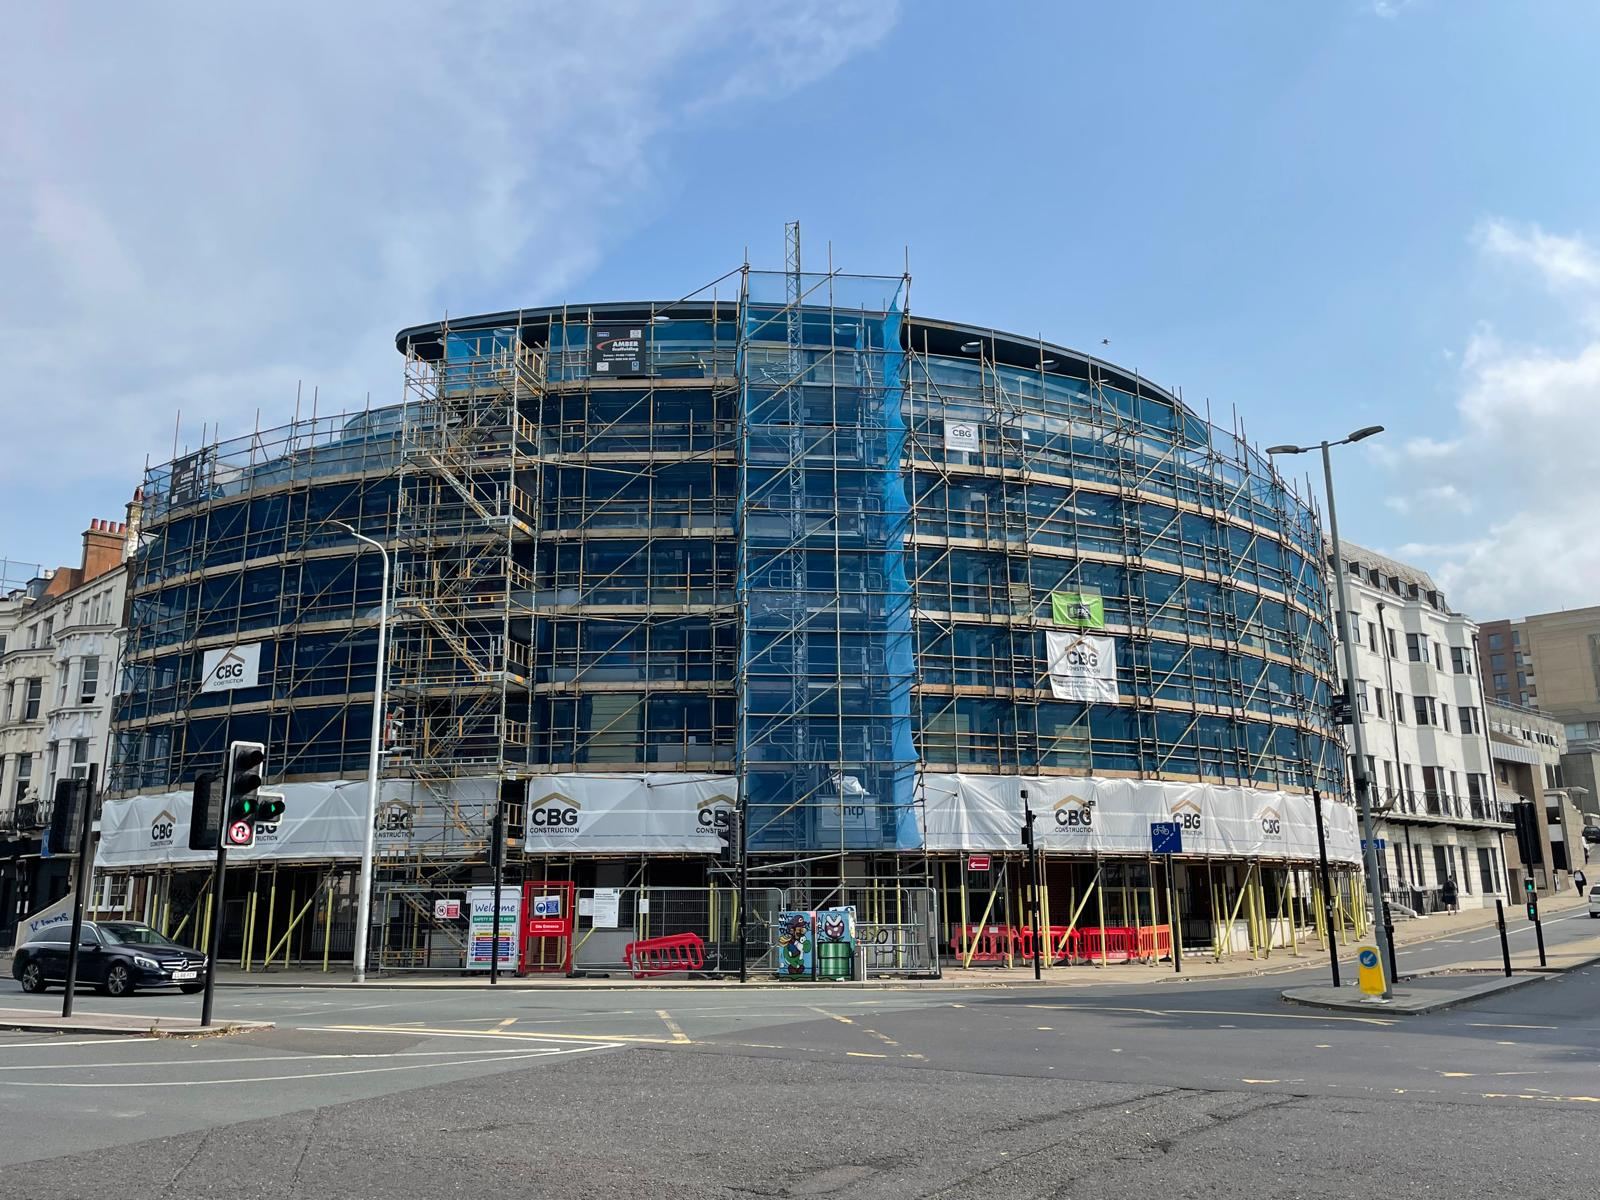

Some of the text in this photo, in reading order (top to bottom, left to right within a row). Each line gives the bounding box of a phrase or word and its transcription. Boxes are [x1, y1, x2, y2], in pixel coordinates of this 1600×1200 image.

[952, 429, 972, 438] CBG
[1067, 651, 1098, 667] CBG
[216, 663, 243, 680] CBG
[532, 808, 578, 826] CBG
[698, 808, 729, 827] CB
[1055, 809, 1092, 826] CBG
[1173, 813, 1201, 830] CBG
[152, 822, 173, 840] CBG
[256, 824, 278, 835] BG
[1262, 818, 1280, 834] CBG
[475, 902, 516, 913] Welcme
